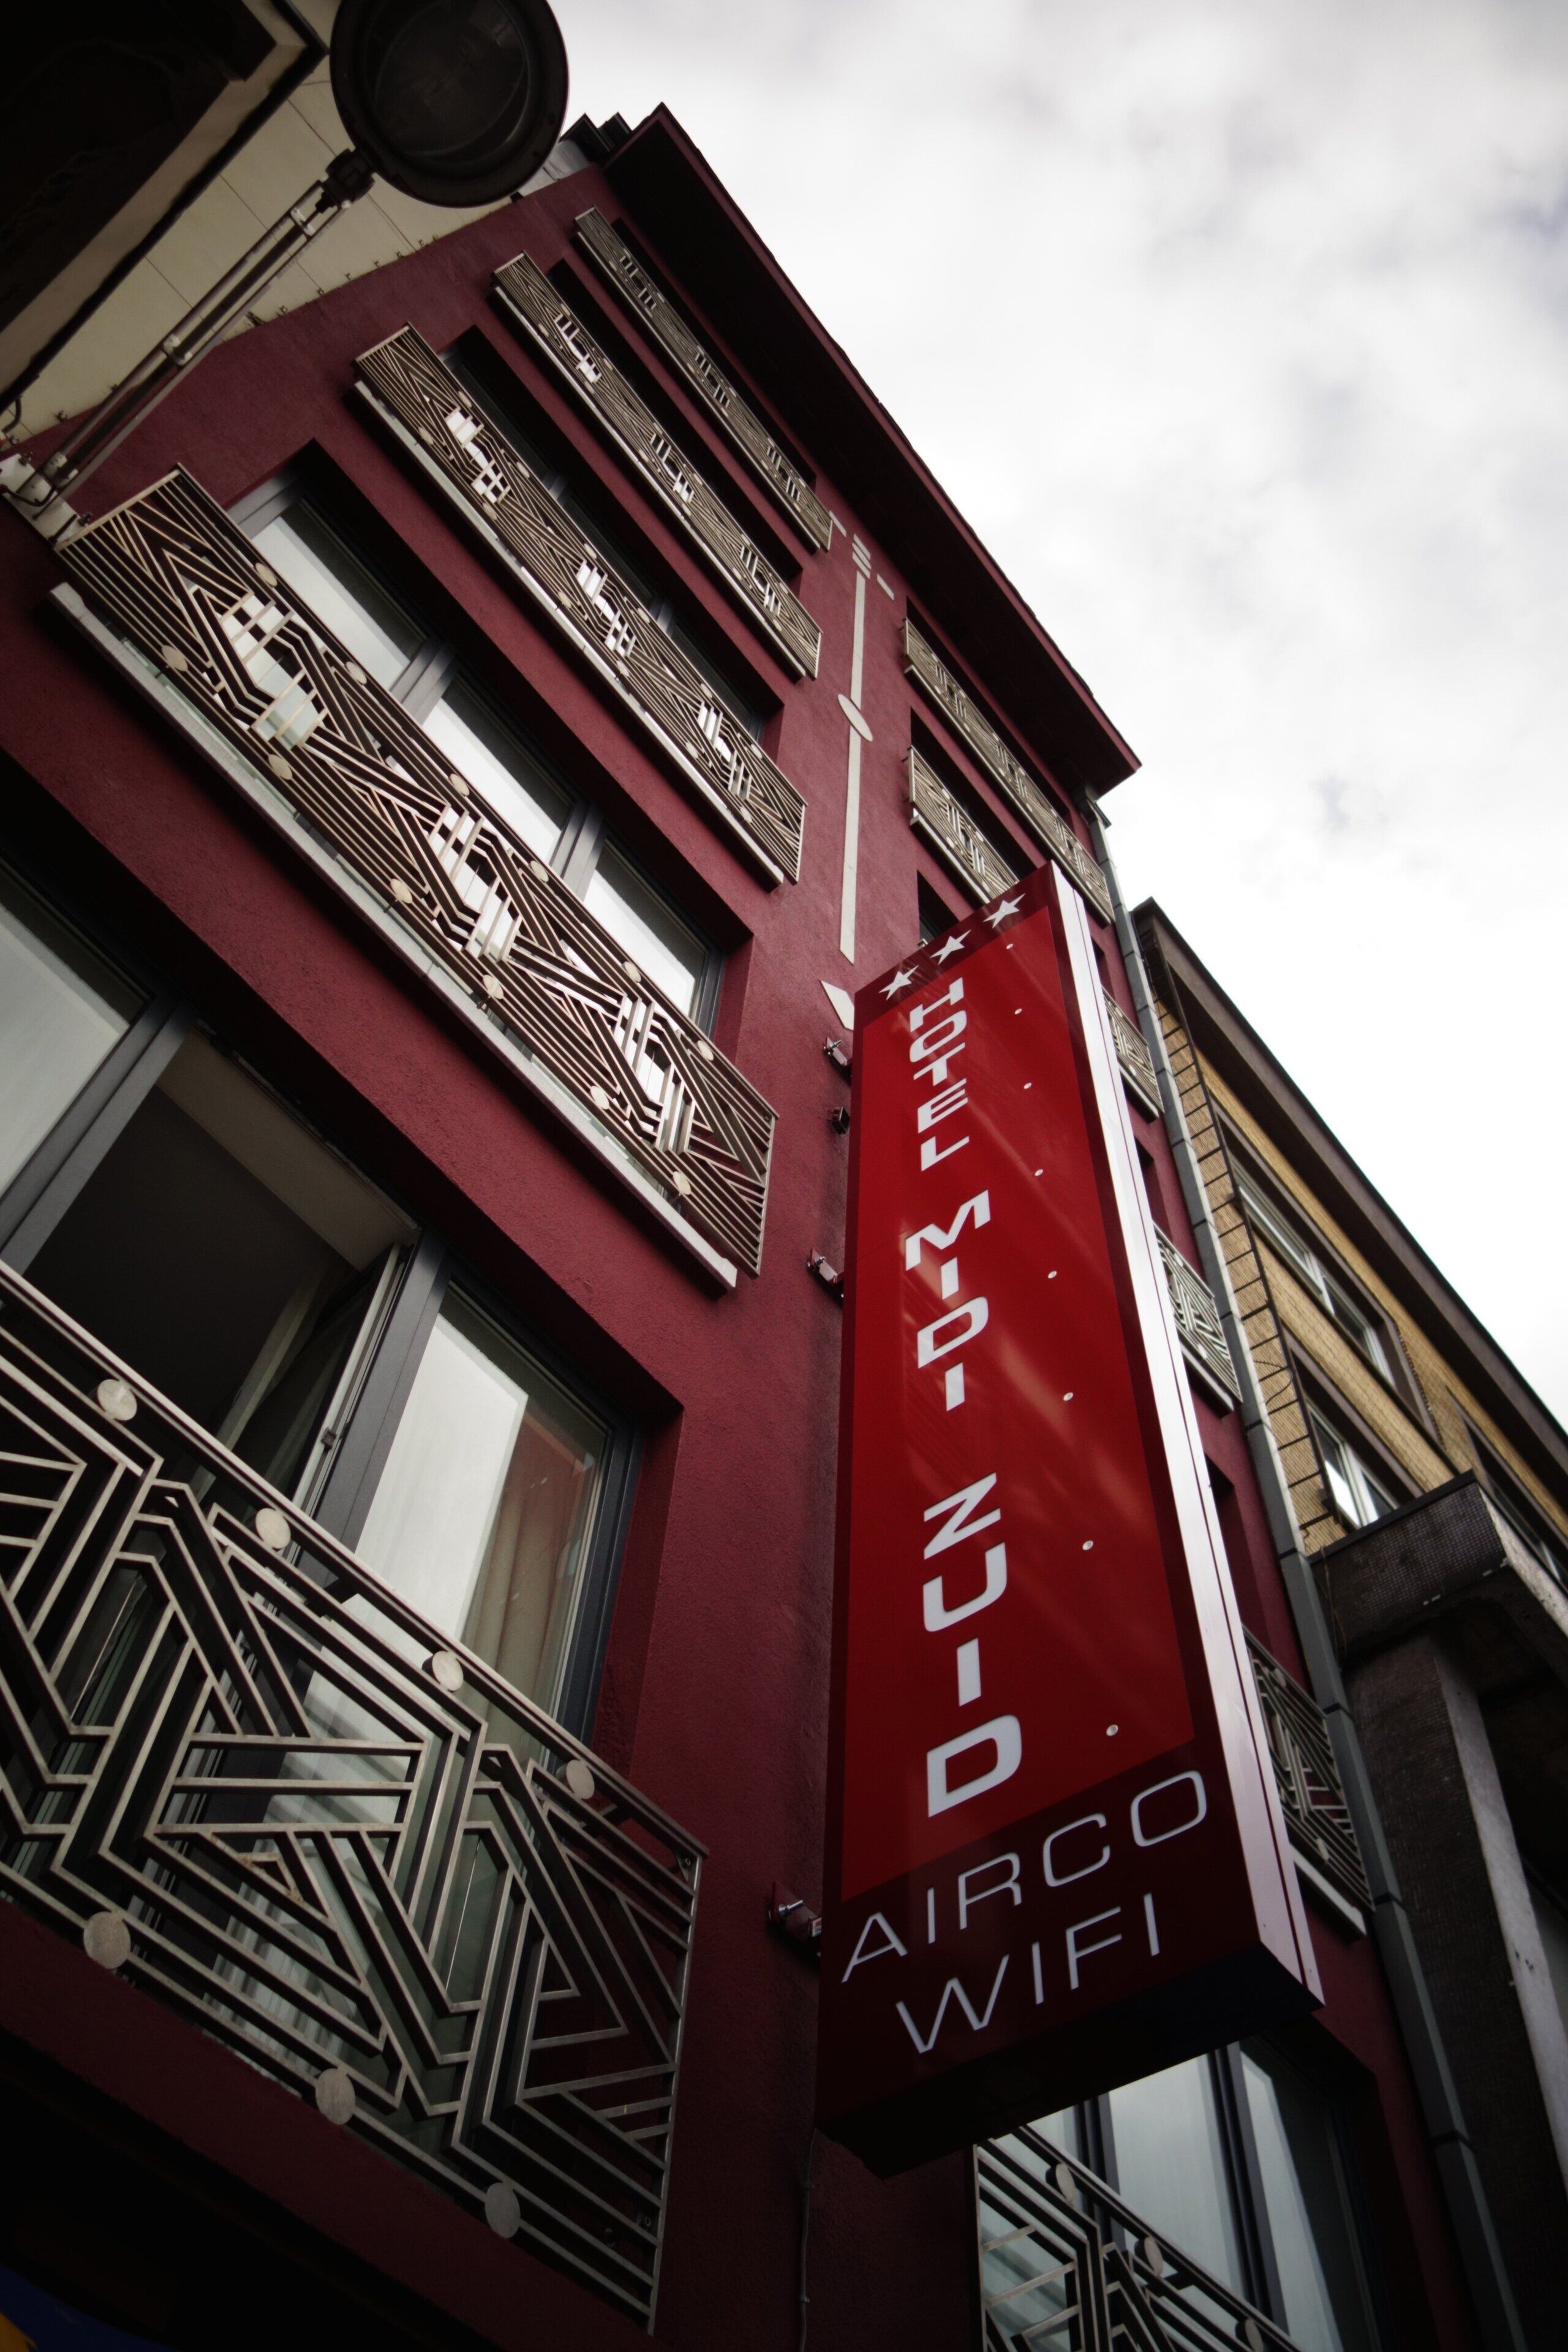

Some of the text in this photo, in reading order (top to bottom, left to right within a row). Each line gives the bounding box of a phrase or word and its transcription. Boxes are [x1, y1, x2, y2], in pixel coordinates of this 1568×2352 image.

[905, 976, 1023, 1819] HOTEL MIDI ZUID
[841, 1770, 1207, 1983] AIRCO
[895, 1891, 1161, 2055] WIFI
